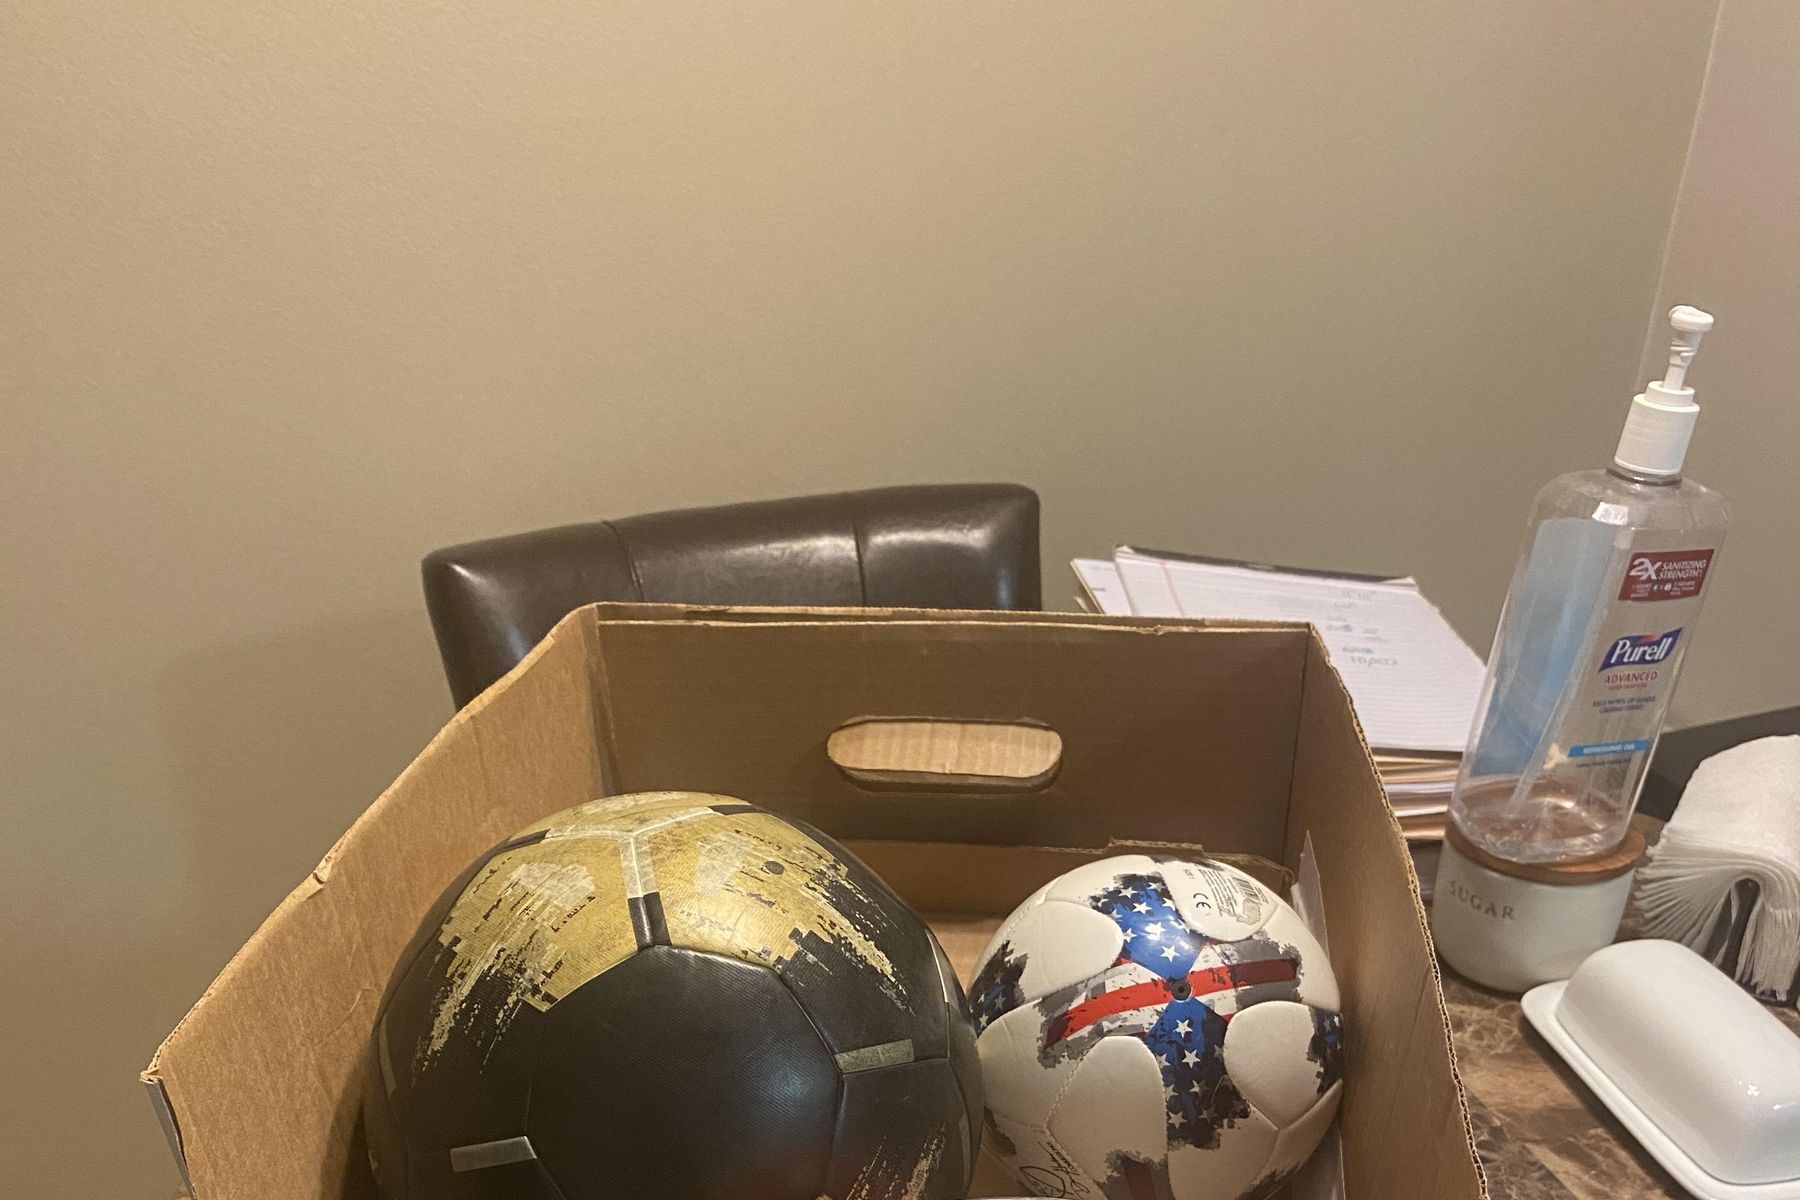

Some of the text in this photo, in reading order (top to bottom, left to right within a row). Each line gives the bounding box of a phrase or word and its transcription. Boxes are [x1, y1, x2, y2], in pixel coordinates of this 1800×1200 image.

[1629, 558, 1707, 580] 2X SANITIZING
[1610, 637, 1672, 664] Purell
[1603, 671, 1658, 684] ADVANCED
[1448, 879, 1515, 920] SUGAR
